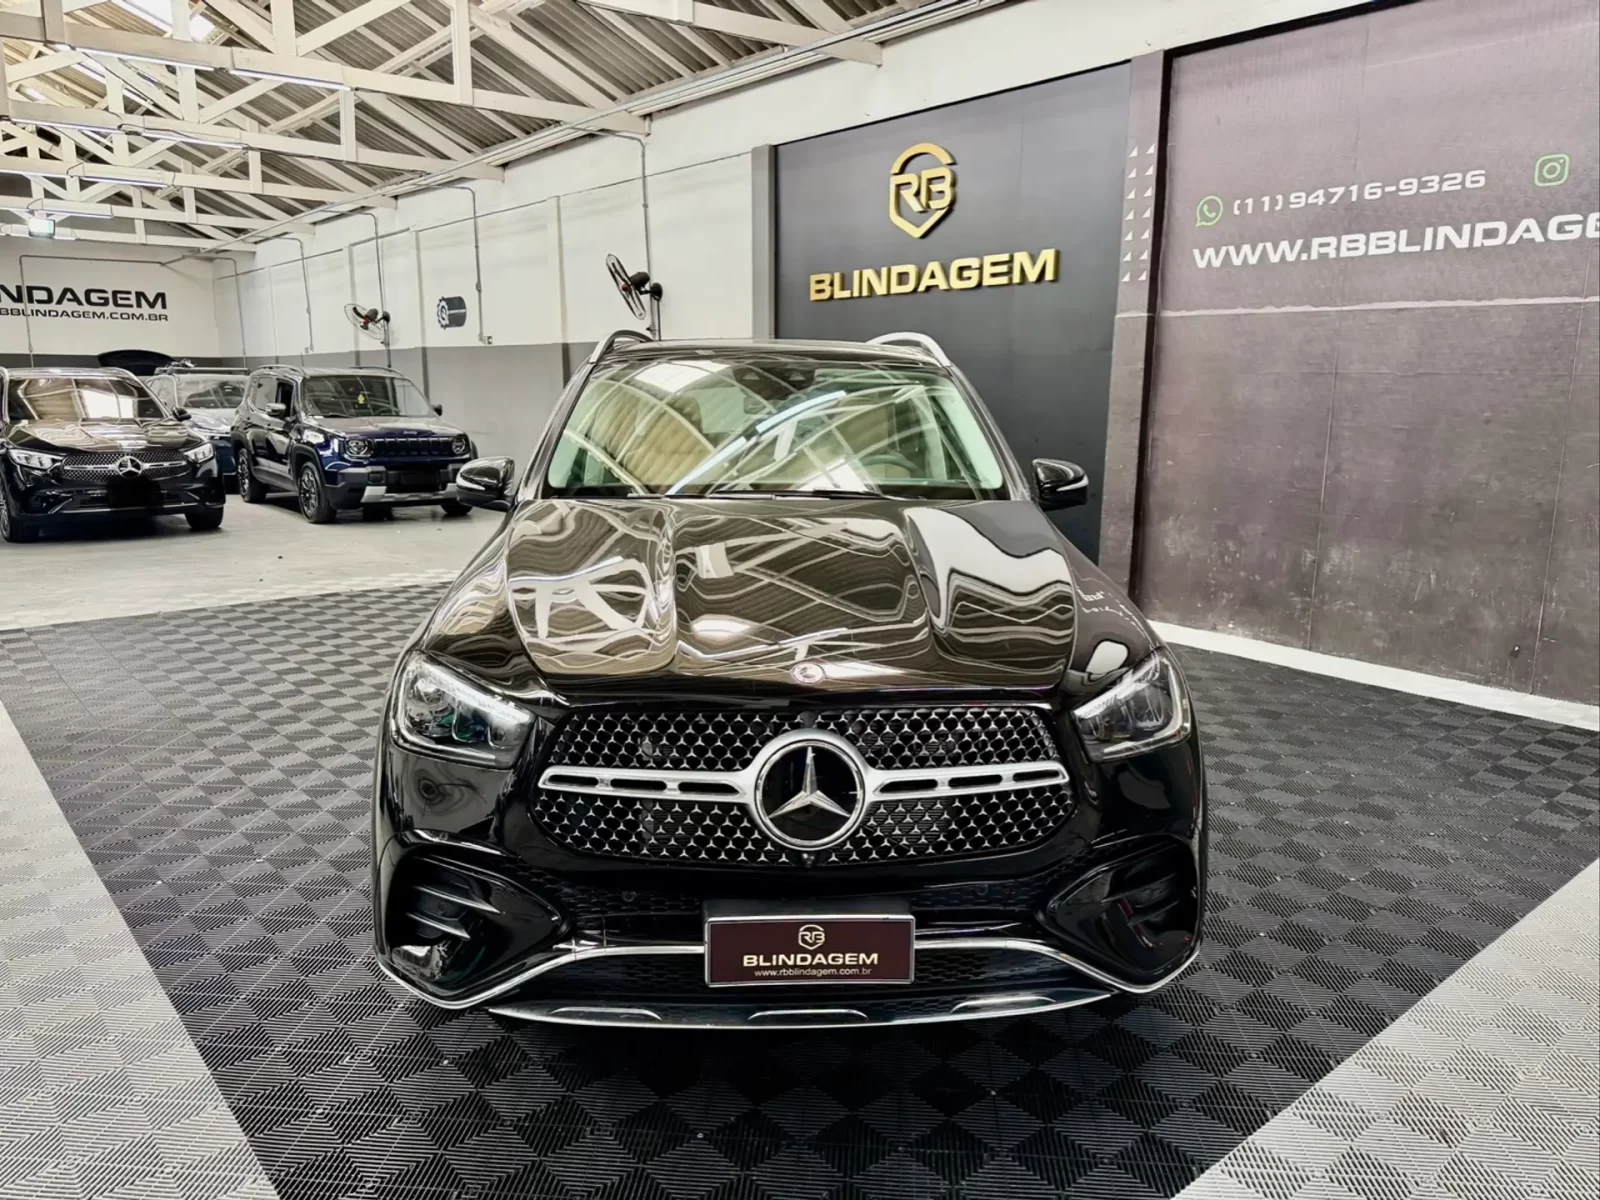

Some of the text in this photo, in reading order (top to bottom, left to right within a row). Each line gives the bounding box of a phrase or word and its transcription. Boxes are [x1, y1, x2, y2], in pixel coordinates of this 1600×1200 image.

[809, 248, 1058, 301] BLINDAGEM
[743, 952, 879, 967] BLINDAGEM
[754, 966, 872, 978] www.rbblindagem.com.br
